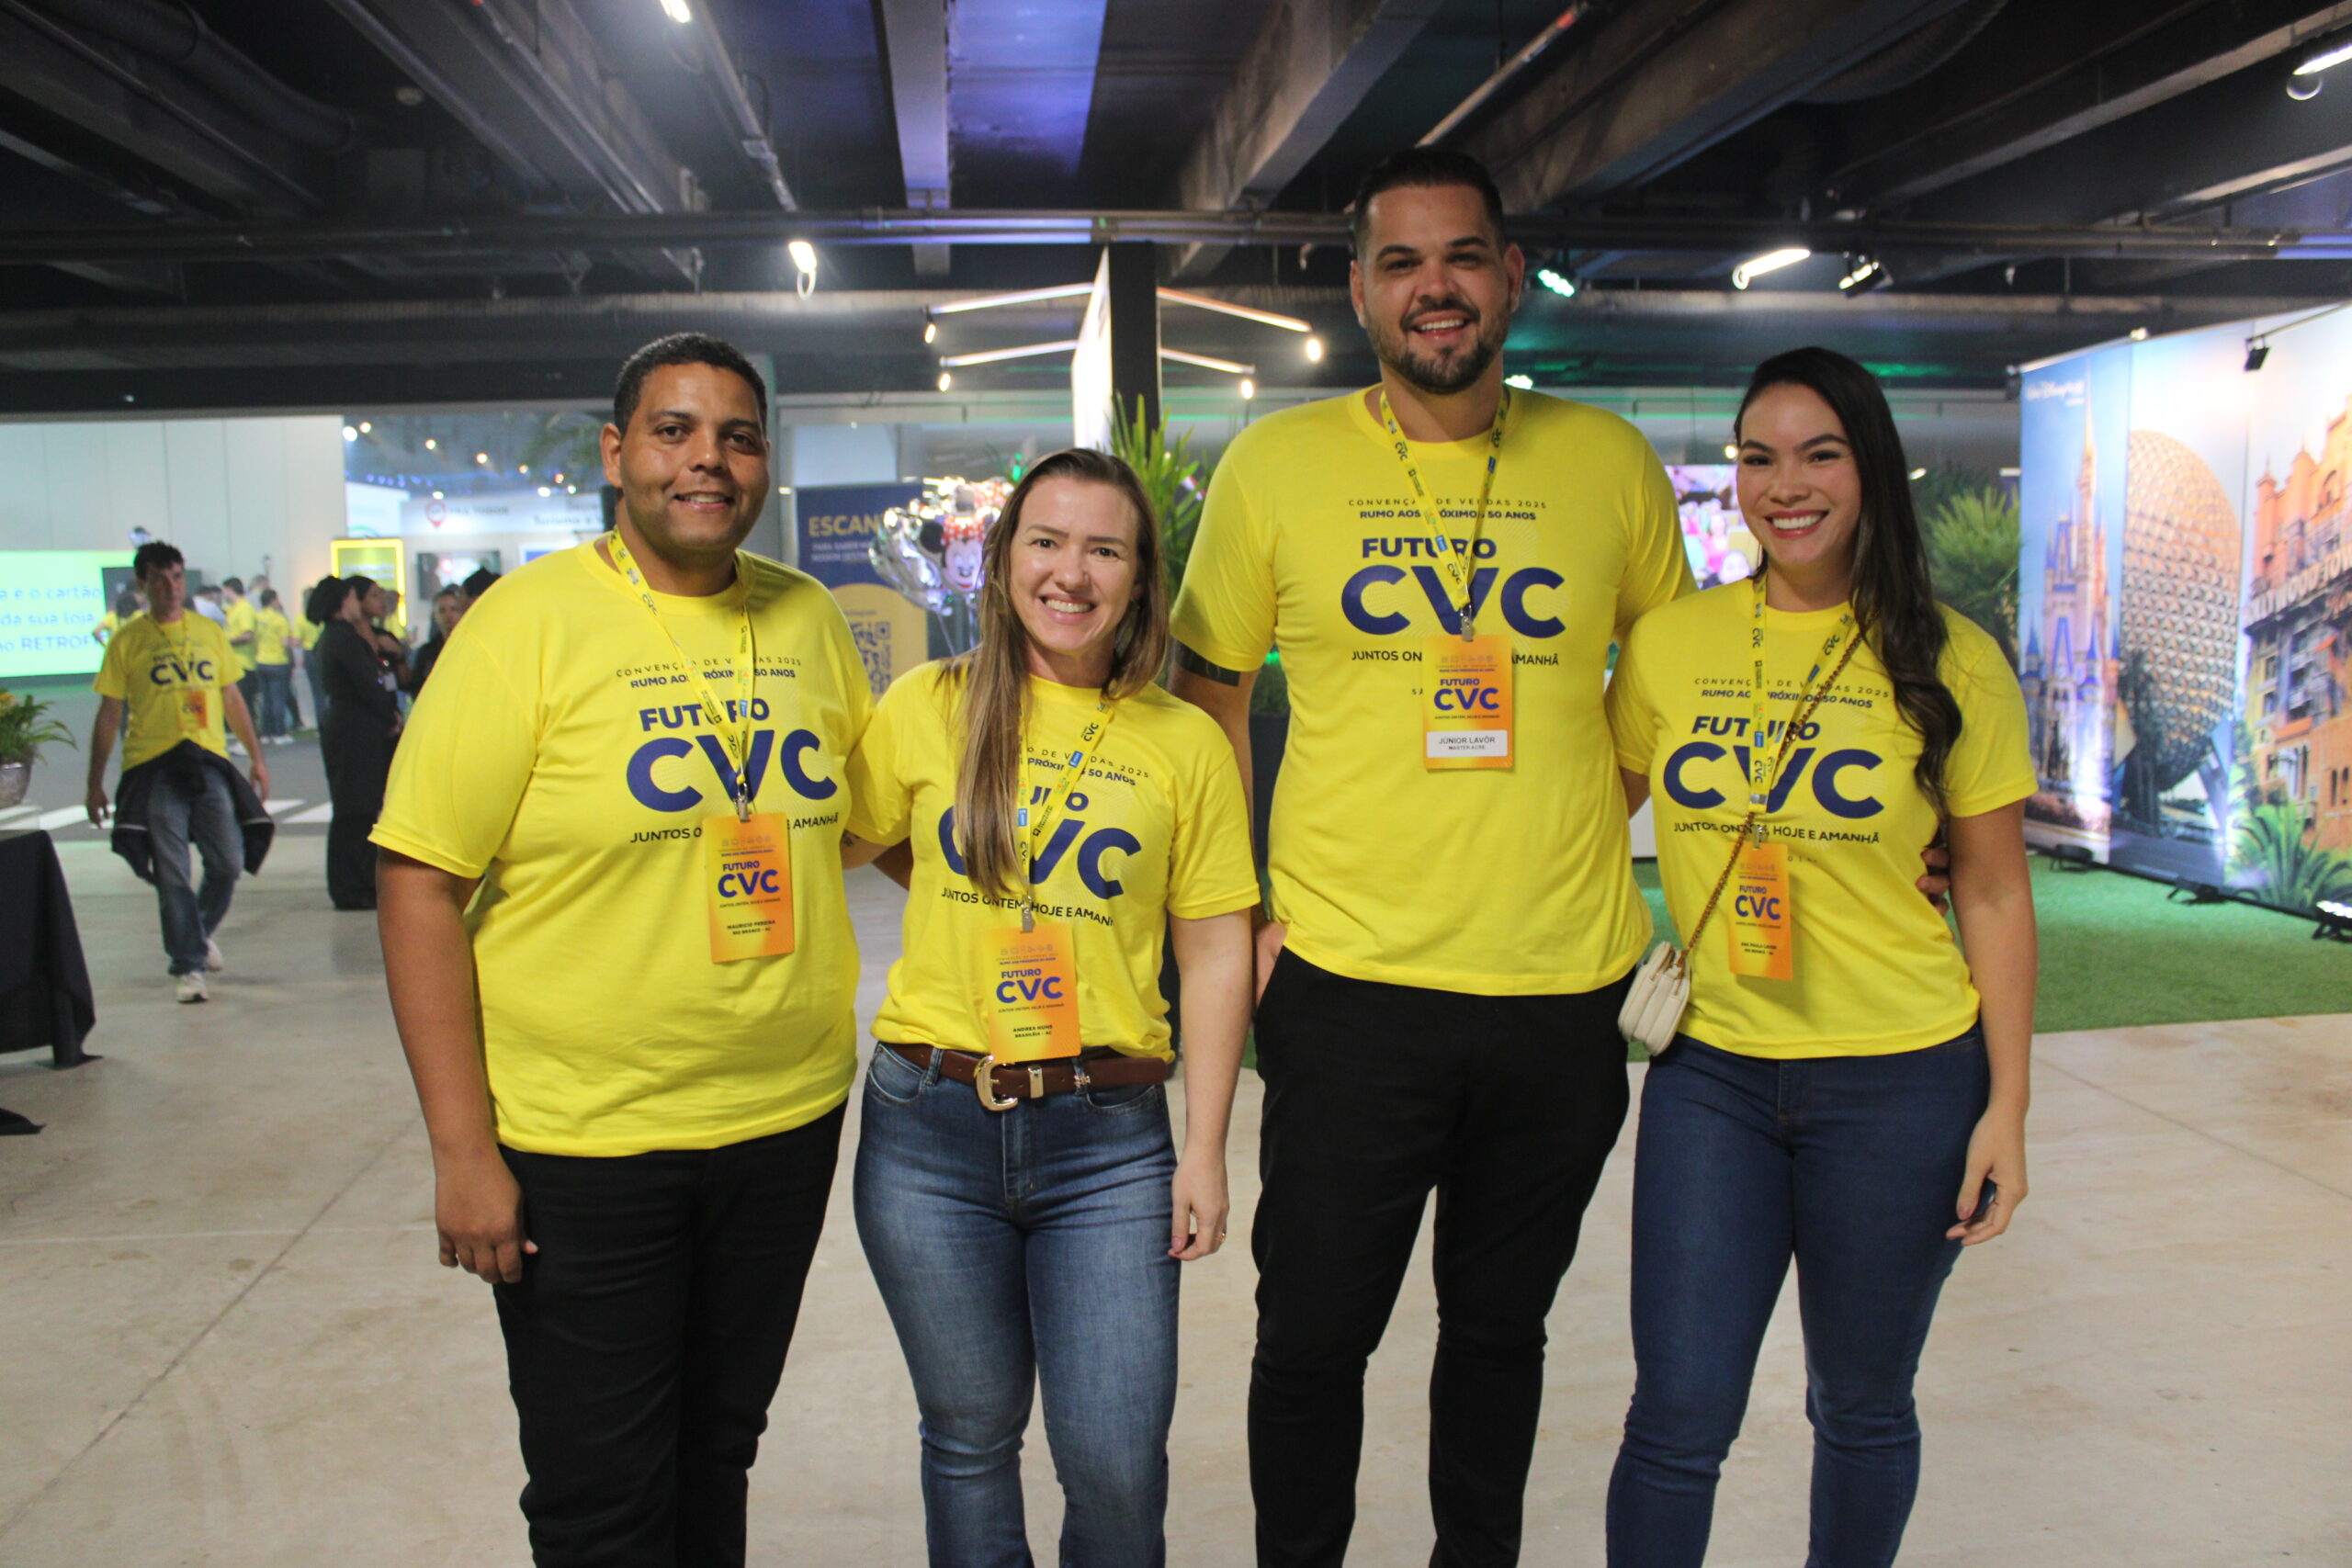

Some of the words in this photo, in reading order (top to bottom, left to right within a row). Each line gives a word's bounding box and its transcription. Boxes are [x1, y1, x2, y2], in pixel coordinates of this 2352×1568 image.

[1518, 500, 1547, 510] 2025
[1360, 510, 1395, 519] RUMO
[1397, 509, 1421, 518] AOS
[1487, 511, 1502, 519] 50
[1505, 511, 1536, 521] ANOS
[1340, 564, 1567, 639] CVC
[777, 656, 801, 666] 2025
[1351, 650, 1399, 662] JUNTOS
[151, 659, 213, 685] CVC
[630, 676, 667, 689] RUMO
[770, 669, 797, 678] ANOS
[1440, 678, 1480, 686] FUTURO
[1777, 680, 1792, 688] DE
[1858, 686, 1889, 698] 2025
[1433, 687, 1499, 711] CVC
[1702, 689, 1735, 698] RUMO
[1839, 696, 1873, 708] ANOS
[1083, 722, 1100, 742] CVC
[627, 728, 838, 812] CVC
[1042, 749, 1057, 758] DE
[1121, 764, 1149, 778] 2025
[1754, 760, 1763, 784] CVC
[1088, 768, 1103, 778] 50
[1105, 772, 1136, 786] ANOS
[1664, 741, 1884, 819] CVC
[793, 812, 839, 829] AMANHÃ
[630, 828, 691, 843] JUNTOS
[1773, 826, 1806, 840] HOJE
[1809, 829, 1815, 840] E
[1818, 830, 1880, 844] AMANHÃ
[722, 861, 761, 872] FUTURO
[718, 869, 780, 898] CVC
[1738, 885, 1768, 895] FUTURO
[1030, 902, 1063, 917] HOJE
[1066, 907, 1073, 917] E
[1735, 895, 1781, 920] CVC
[1001, 968, 1042, 979] FUTURO
[996, 976, 1064, 1003] CVC
